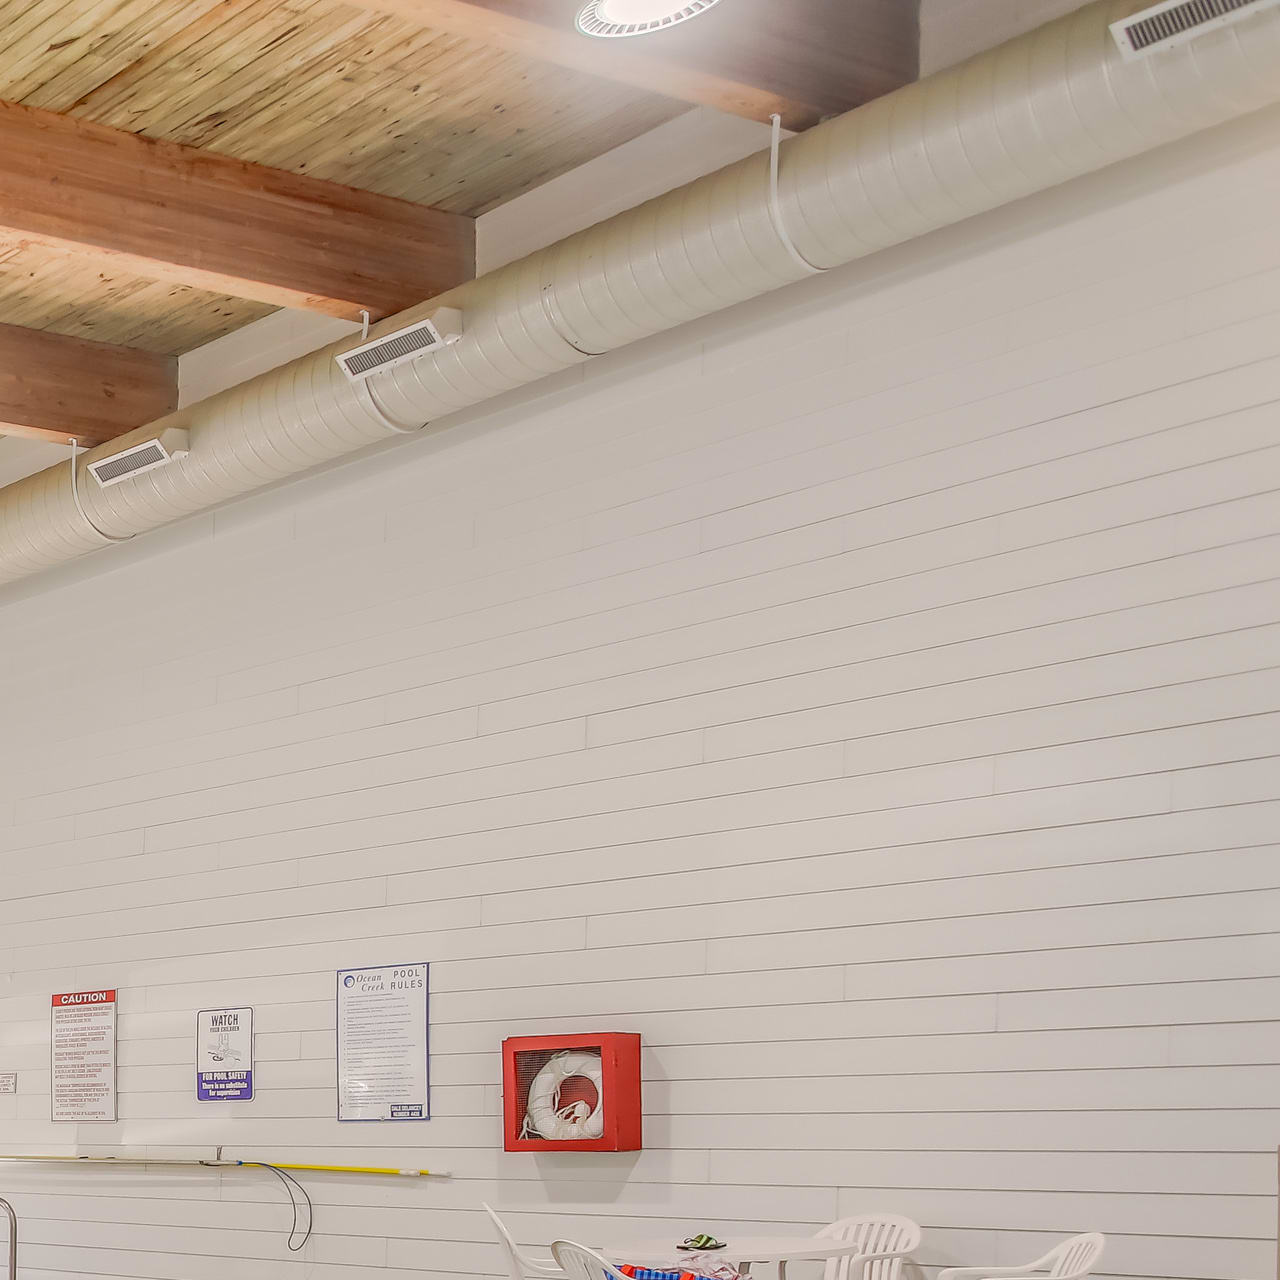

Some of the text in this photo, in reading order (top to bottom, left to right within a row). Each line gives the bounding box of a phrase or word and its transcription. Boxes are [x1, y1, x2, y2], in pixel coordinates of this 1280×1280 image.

[356, 968, 420, 983] Ocean POOL
[361, 979, 424, 992] Creek RULES
[61, 991, 107, 1004] CAUTION
[210, 1013, 239, 1027] WATCH
[202, 1071, 247, 1081] FOR POOL SAFETY
